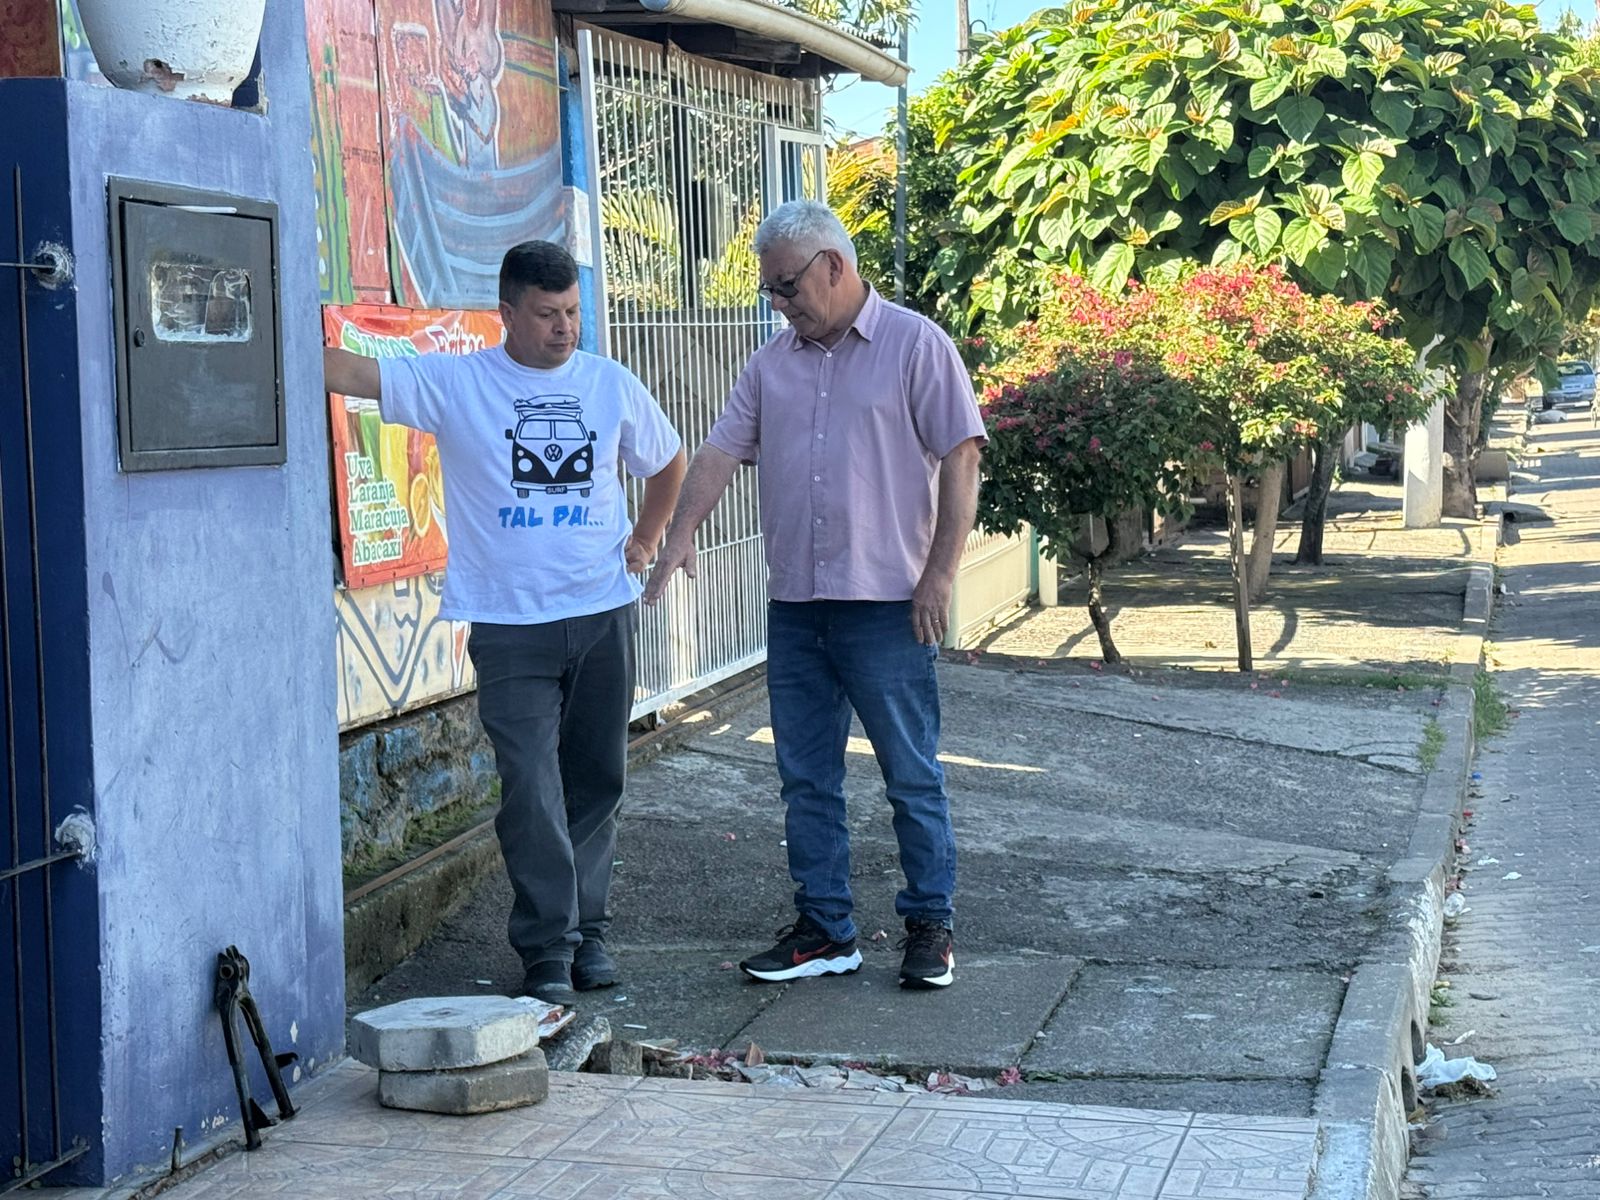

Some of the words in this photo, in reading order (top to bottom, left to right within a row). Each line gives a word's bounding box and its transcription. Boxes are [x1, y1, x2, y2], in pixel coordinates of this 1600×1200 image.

[346, 454, 373, 478] Uva
[348, 478, 396, 505] Laranja
[498, 506, 543, 528] TAL
[354, 540, 401, 563] Abacaxi
